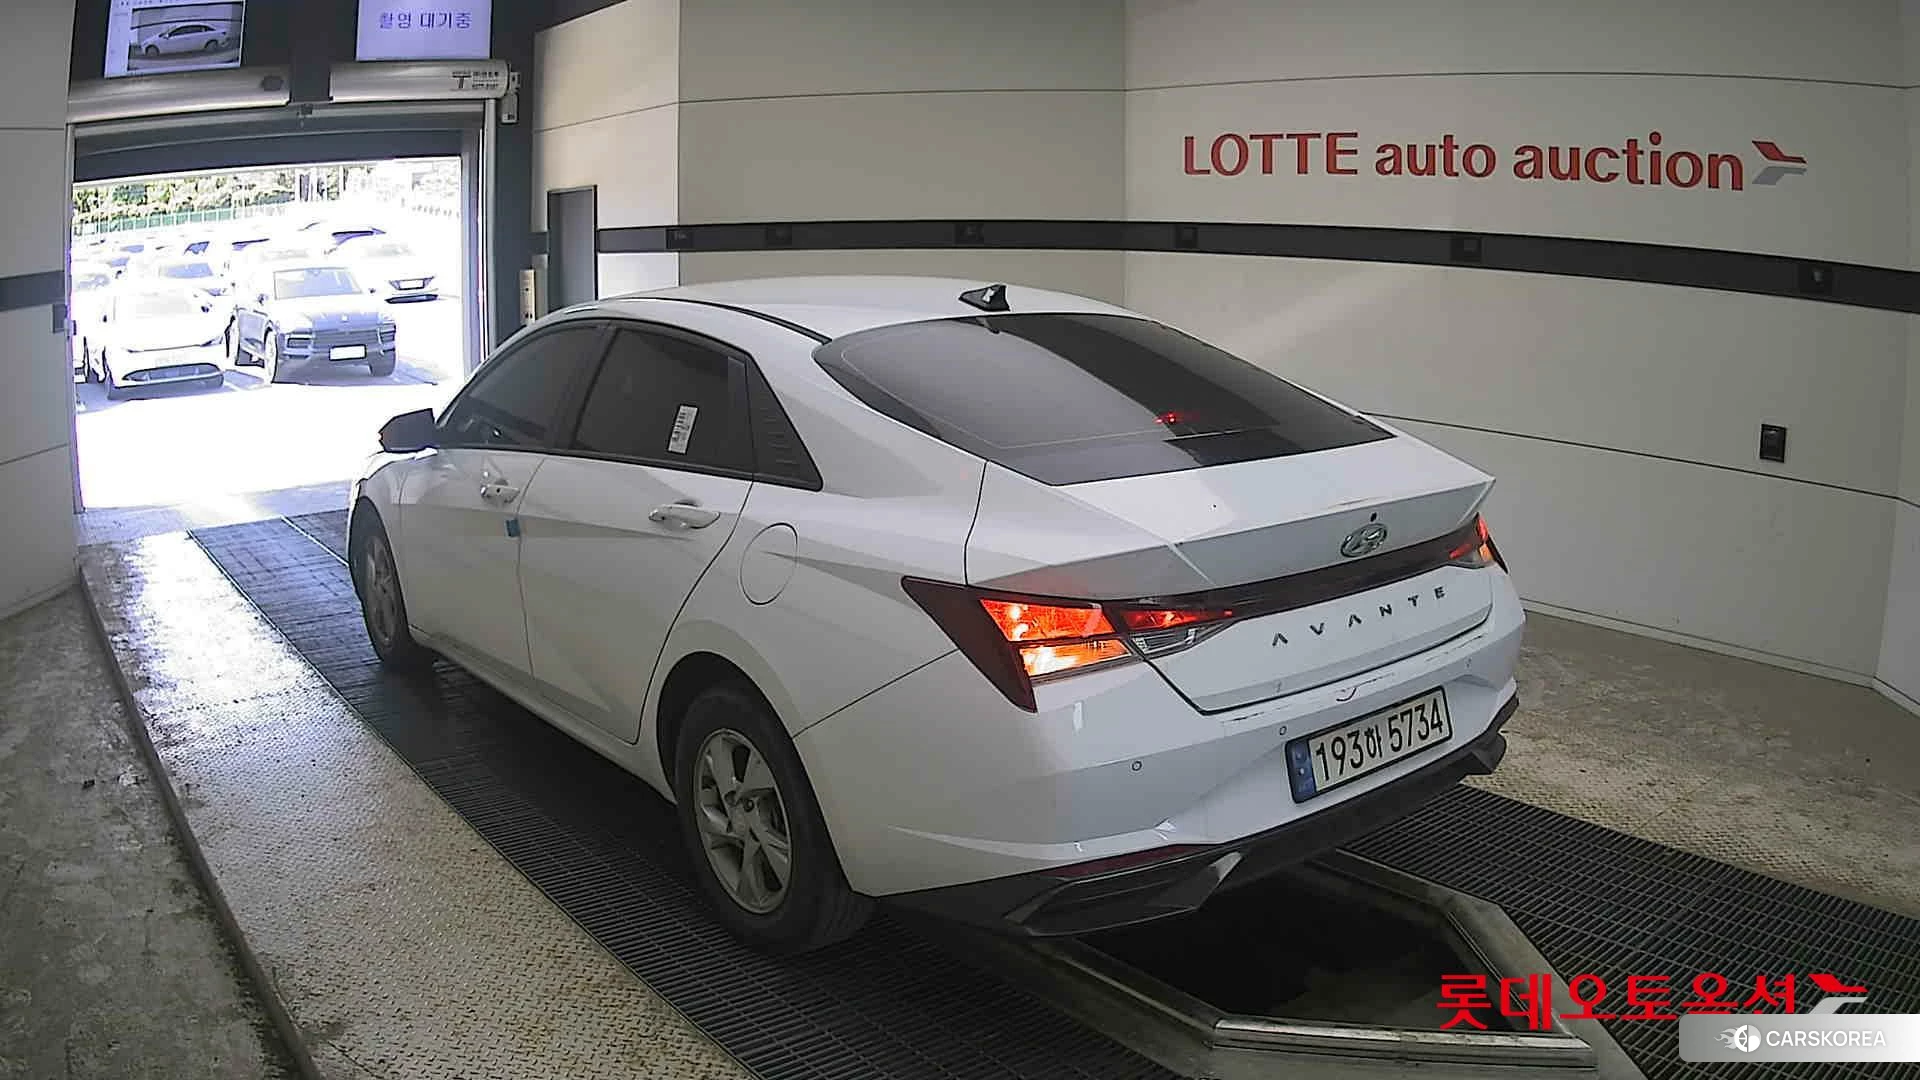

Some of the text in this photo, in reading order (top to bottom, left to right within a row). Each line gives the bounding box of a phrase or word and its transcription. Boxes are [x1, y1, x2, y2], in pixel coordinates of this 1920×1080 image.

[1184, 132, 1744, 191] LOTTE auto auction
[1271, 586, 1446, 647] AVANTE
[1386, 697, 1445, 753] 5734
